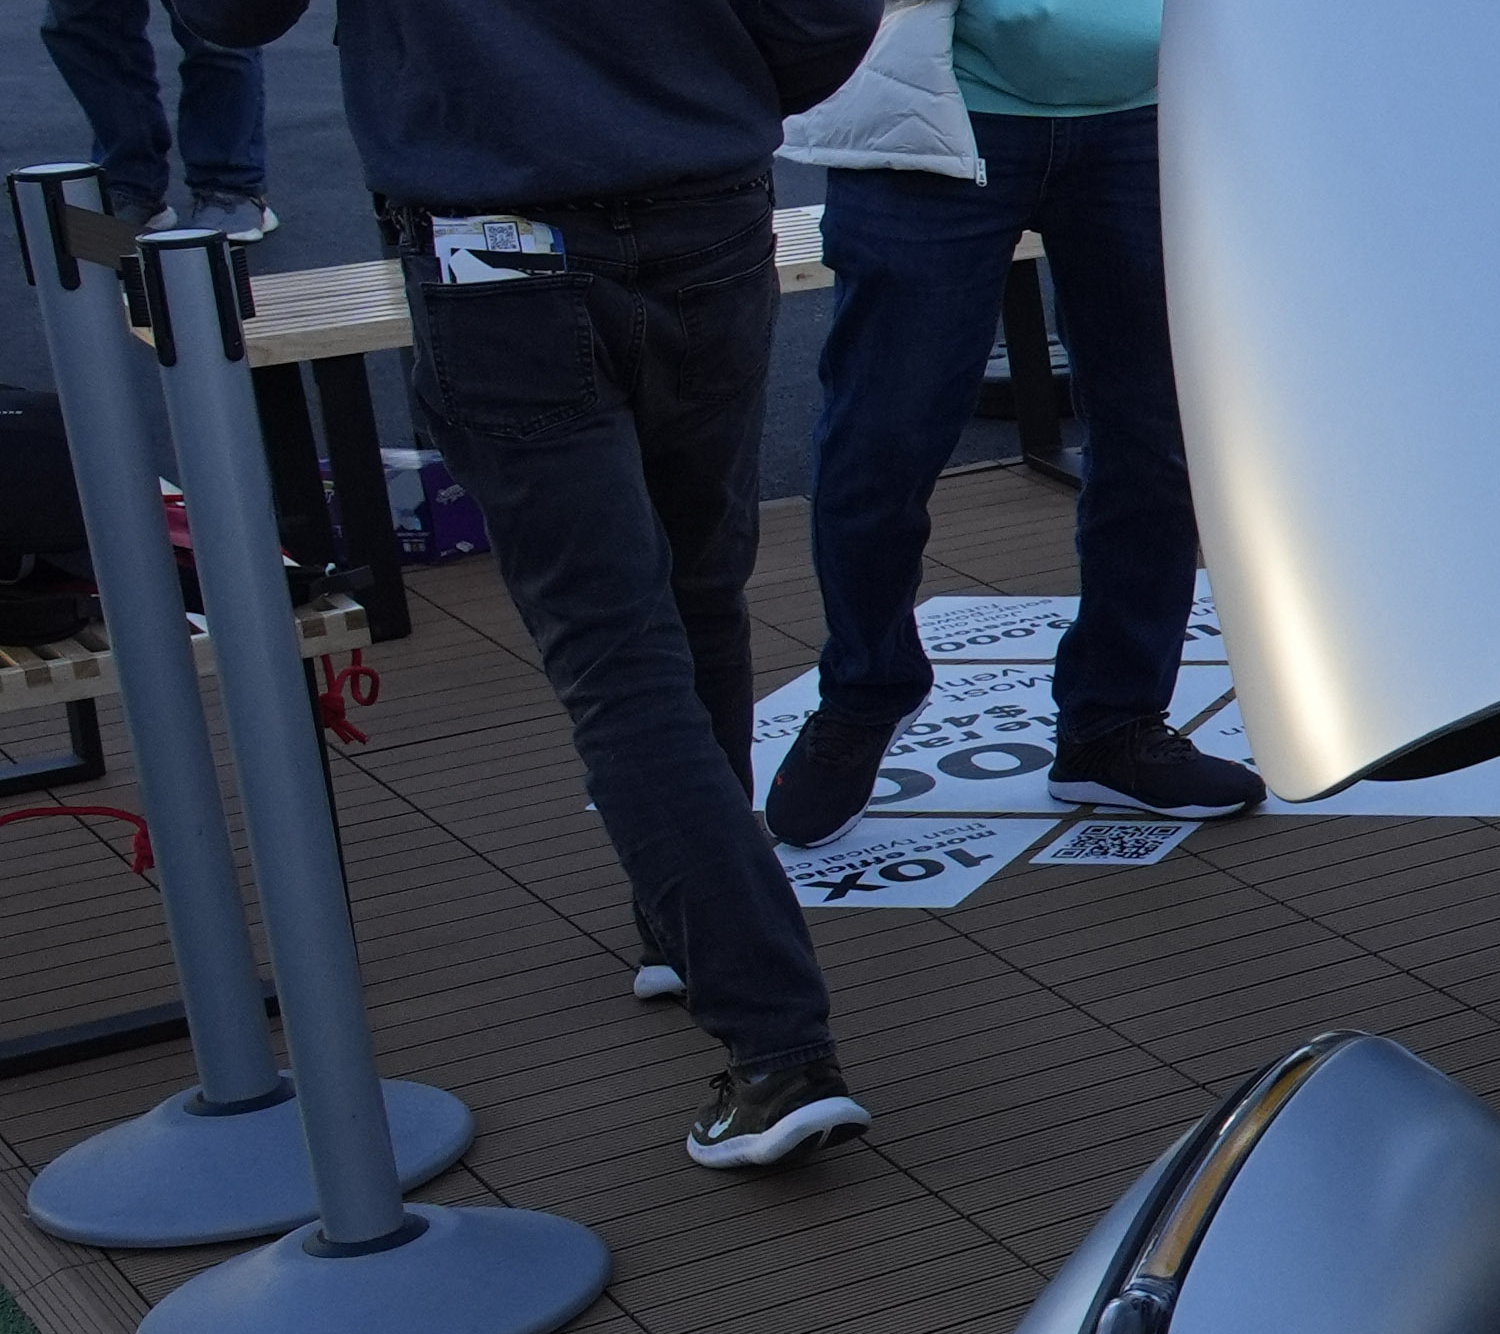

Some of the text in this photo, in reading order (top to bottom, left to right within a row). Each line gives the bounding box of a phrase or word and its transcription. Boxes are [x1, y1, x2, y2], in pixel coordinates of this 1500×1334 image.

[974, 610, 1022, 624] Join
[934, 668, 1024, 693] vehi
[912, 830, 997, 853] more
[922, 823, 987, 840] than
[821, 838, 918, 864] typical
